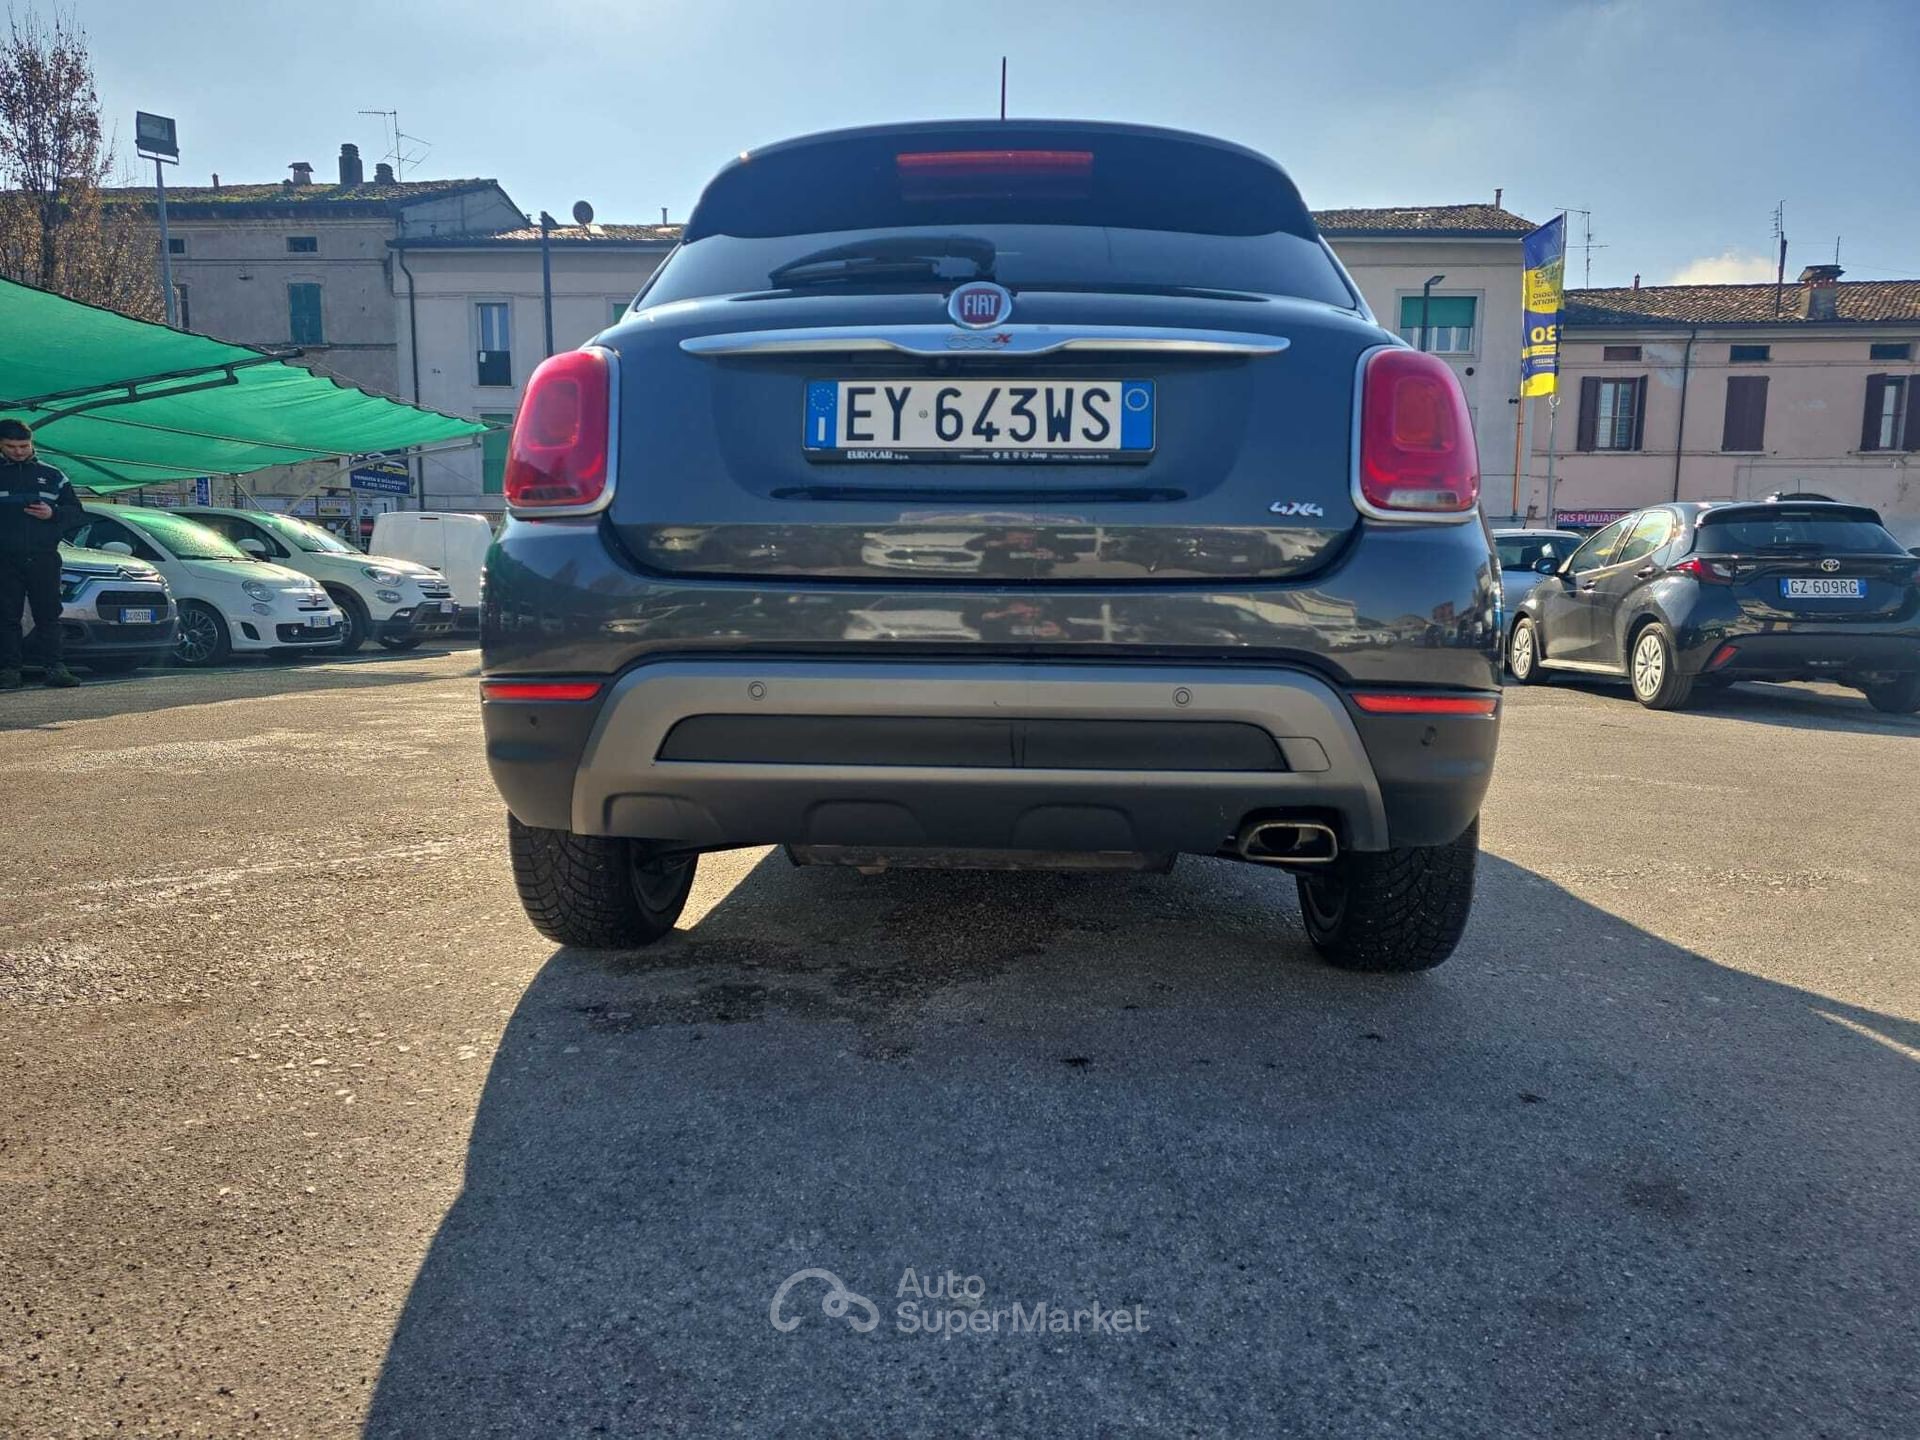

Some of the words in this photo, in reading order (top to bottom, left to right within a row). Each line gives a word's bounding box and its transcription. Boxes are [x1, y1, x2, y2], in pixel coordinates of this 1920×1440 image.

[964, 294, 999, 316] FIAT
[846, 387, 911, 441] EY
[935, 387, 1111, 442] 643WS
[1558, 513, 1575, 523] SKS
[1791, 580, 1808, 594] GZ
[1812, 580, 1858, 594] 609RG
